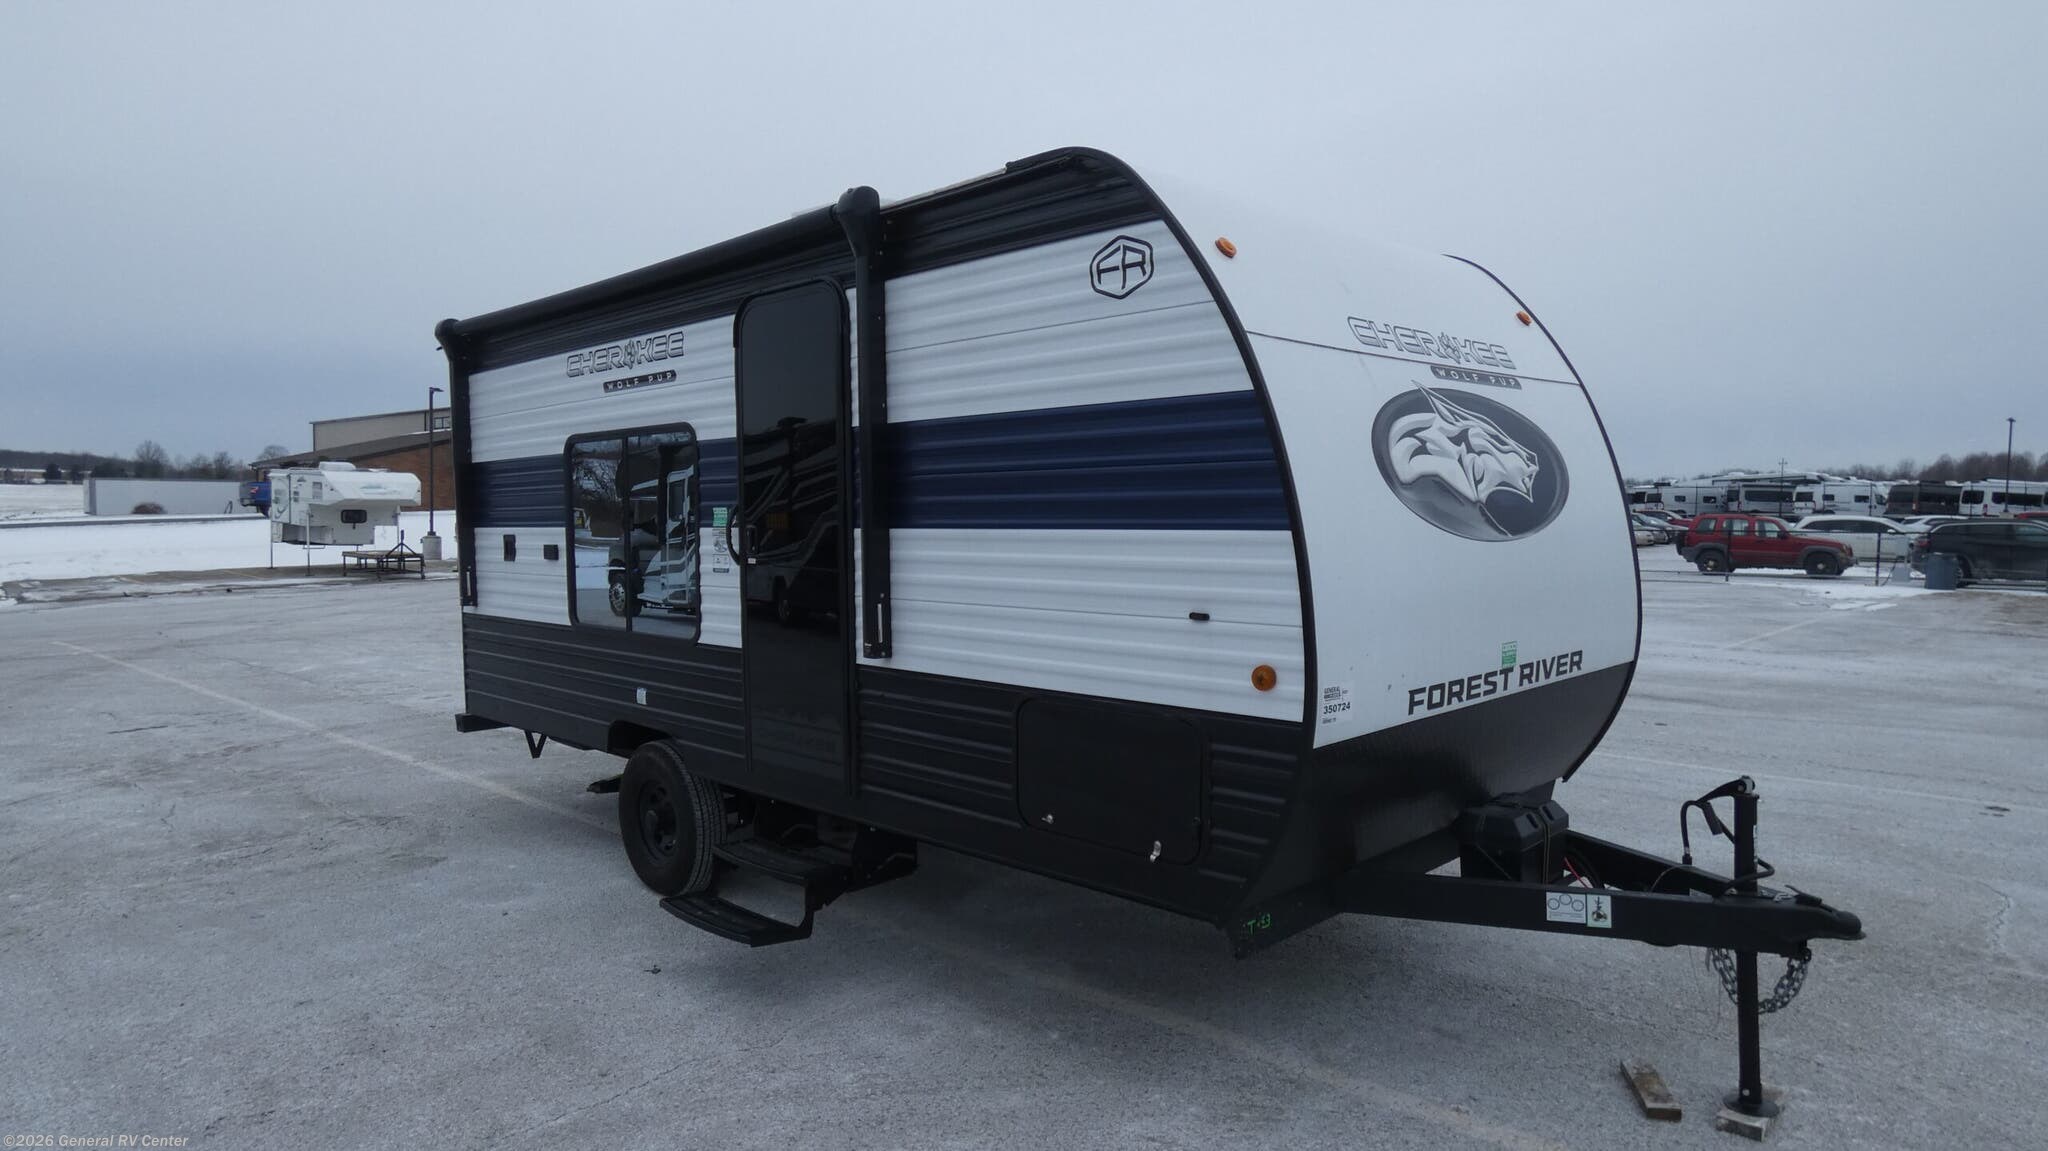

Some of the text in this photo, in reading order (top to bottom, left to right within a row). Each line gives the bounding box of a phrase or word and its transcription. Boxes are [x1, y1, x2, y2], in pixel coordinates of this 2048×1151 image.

[566, 331, 685, 378] CHEROKEE
[1347, 316, 1517, 370] CHEROKEE
[606, 372, 673, 391] WOLF PUP
[1436, 367, 1517, 387] WOLF PUP
[1408, 666, 1514, 716] FOREST
[1519, 650, 1583, 687] RIVER
[1323, 702, 1351, 715] 350724
